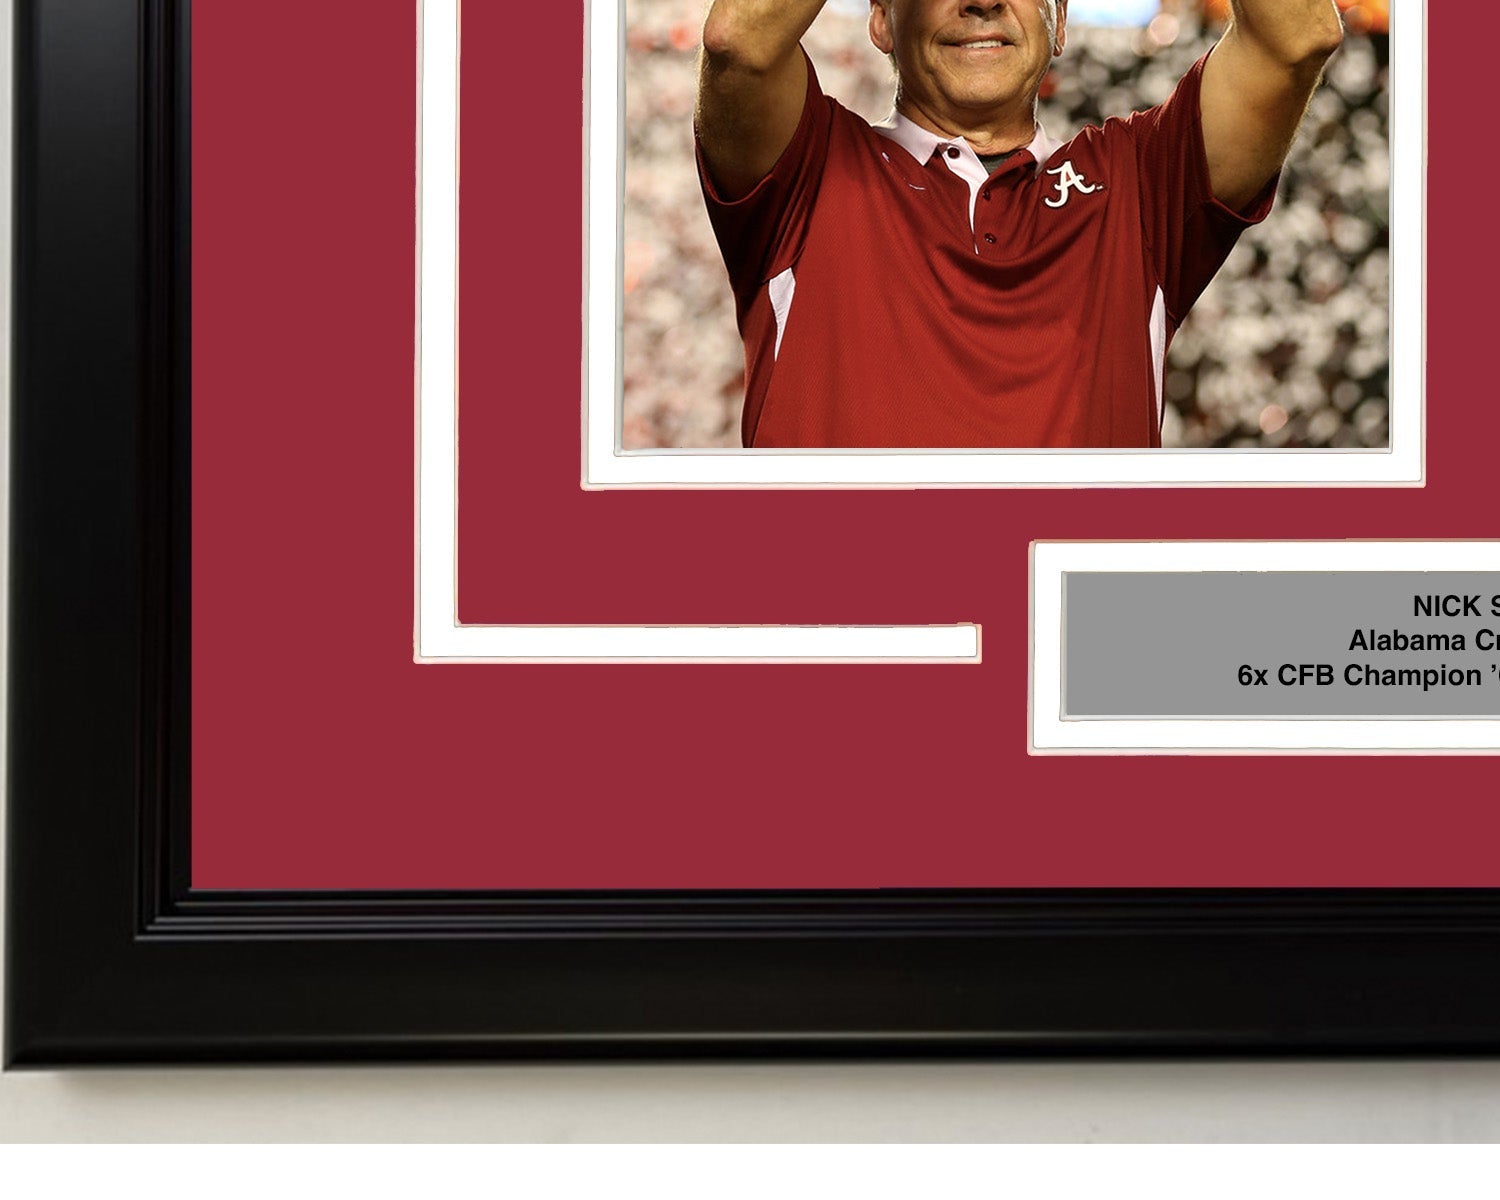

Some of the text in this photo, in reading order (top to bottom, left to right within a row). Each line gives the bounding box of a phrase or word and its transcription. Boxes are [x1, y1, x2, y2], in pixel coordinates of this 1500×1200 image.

[1045, 160, 1096, 208] A
[1413, 594, 1482, 618] NICK
[1348, 628, 1466, 652] Alabama
[1237, 664, 1269, 687] 6x
[1277, 663, 1335, 687] CFB
[1343, 663, 1482, 692] Champion
